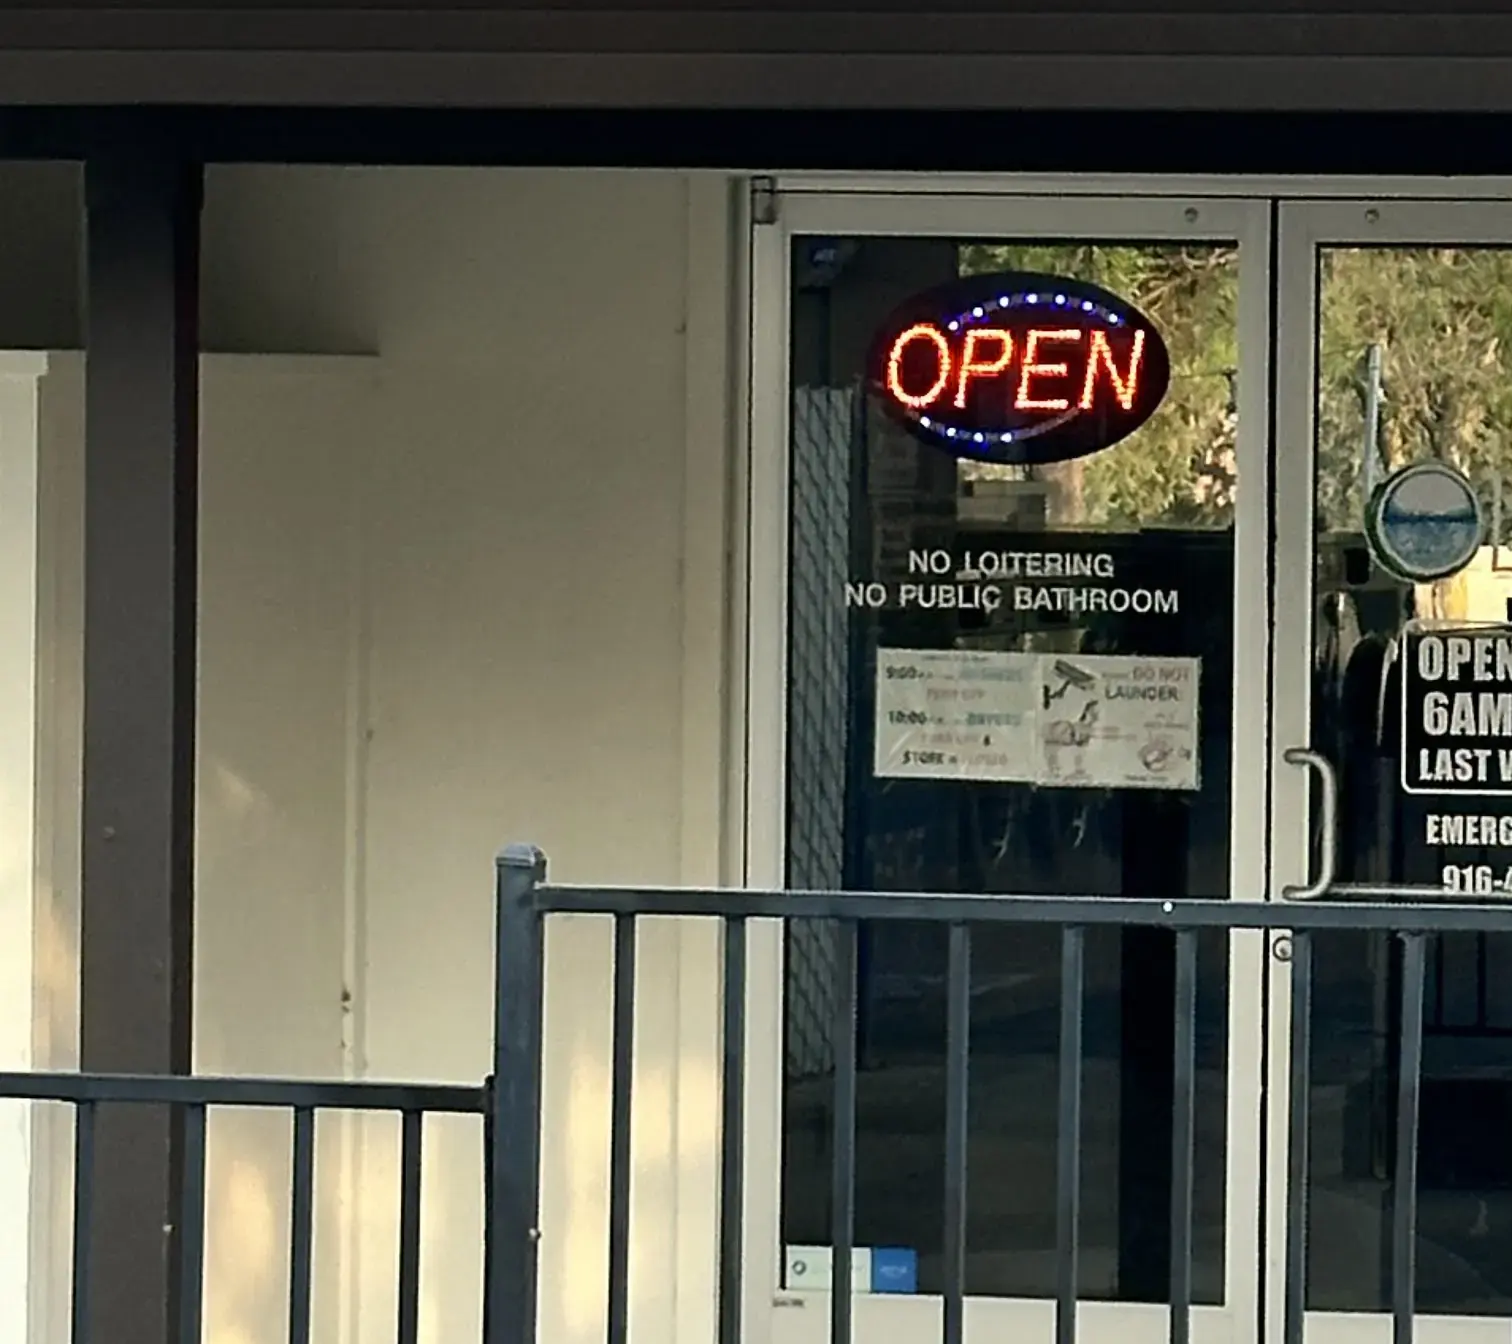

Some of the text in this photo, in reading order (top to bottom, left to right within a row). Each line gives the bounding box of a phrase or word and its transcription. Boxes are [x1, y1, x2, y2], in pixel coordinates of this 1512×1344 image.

[887, 321, 1146, 409] OPEN
[908, 549, 1115, 578] NO LOITERING
[845, 583, 1179, 613] NO PUBLIC BATHROOM
[1419, 748, 1492, 782] LAST
